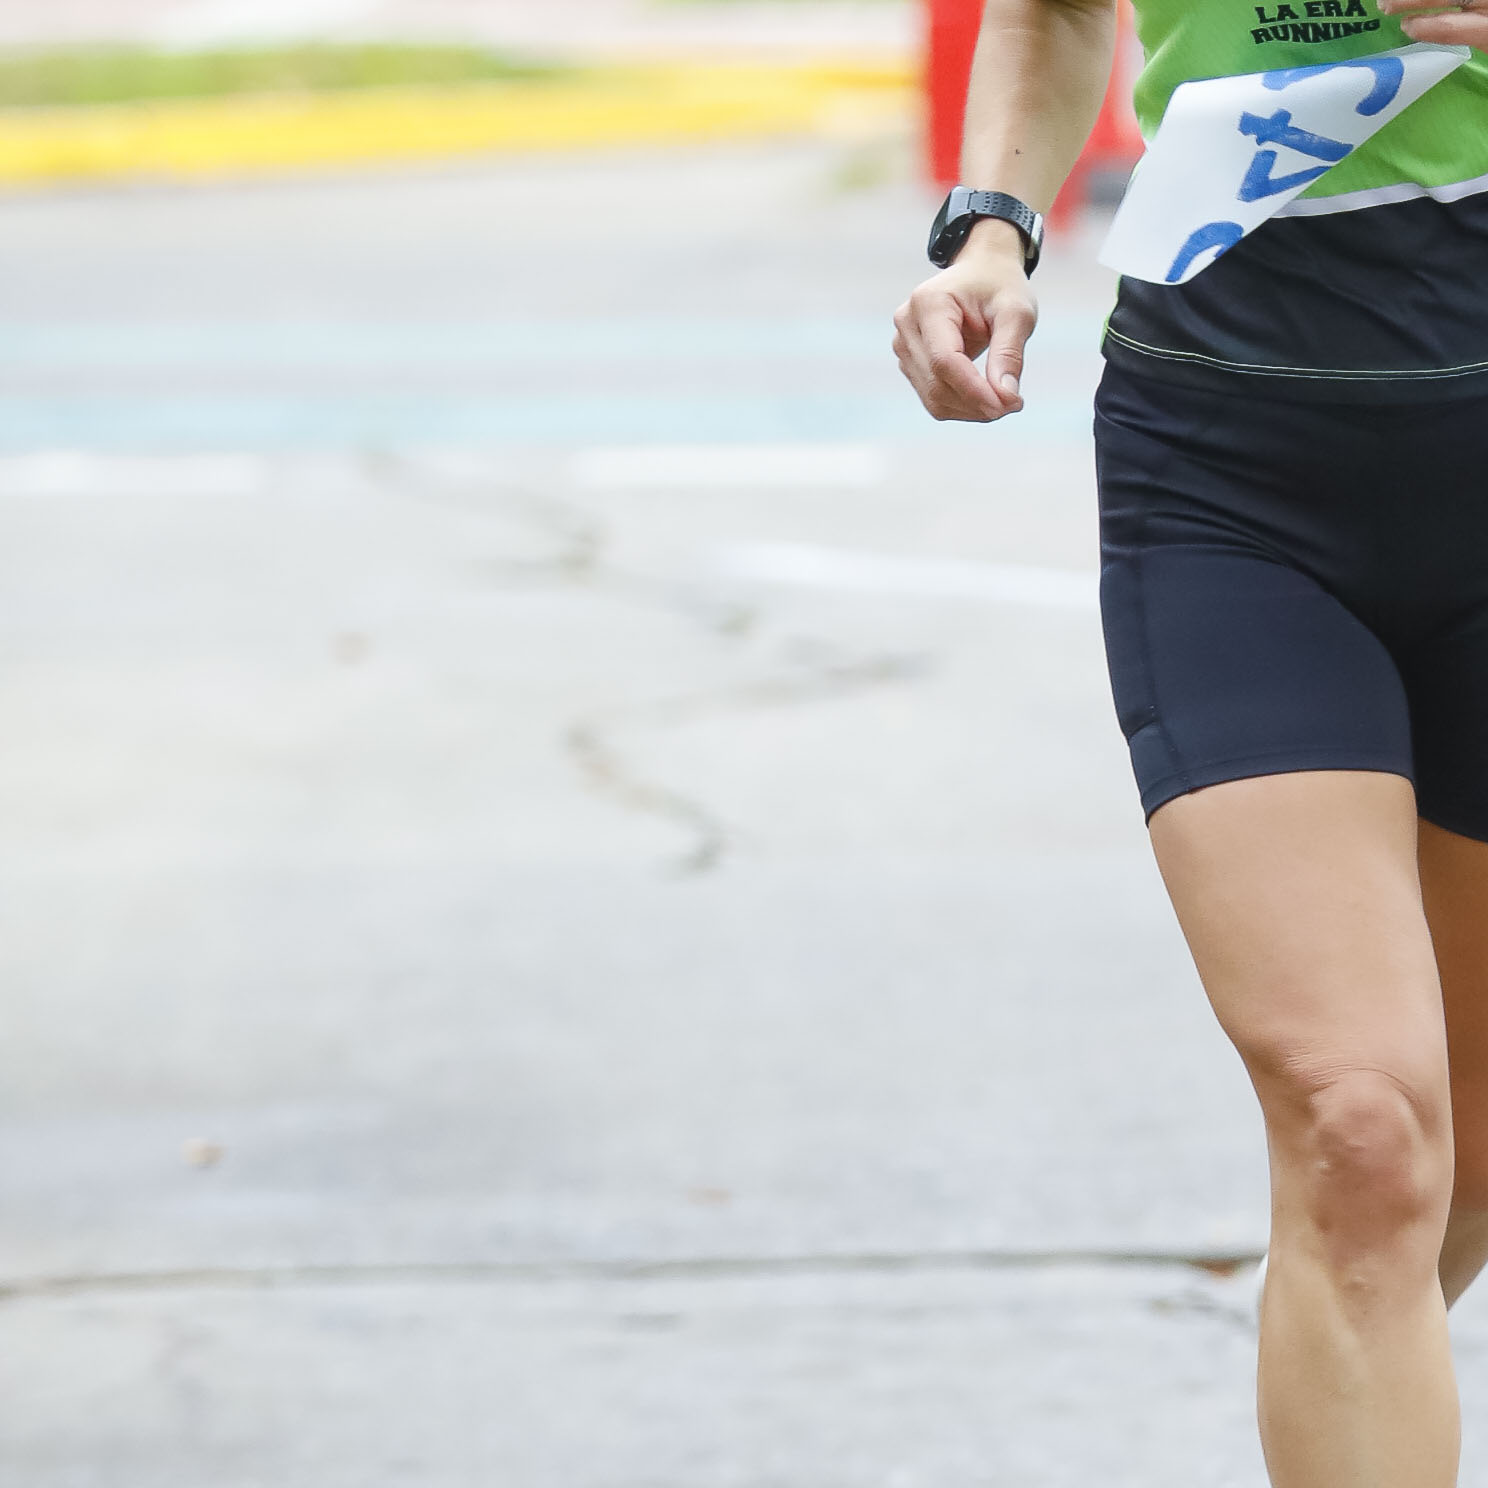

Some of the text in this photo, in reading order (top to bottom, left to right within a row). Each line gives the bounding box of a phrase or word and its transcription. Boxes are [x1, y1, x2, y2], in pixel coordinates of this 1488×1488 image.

[1255, 0, 1367, 23] LA ERA
[1250, 19, 1380, 44] RUNNING
